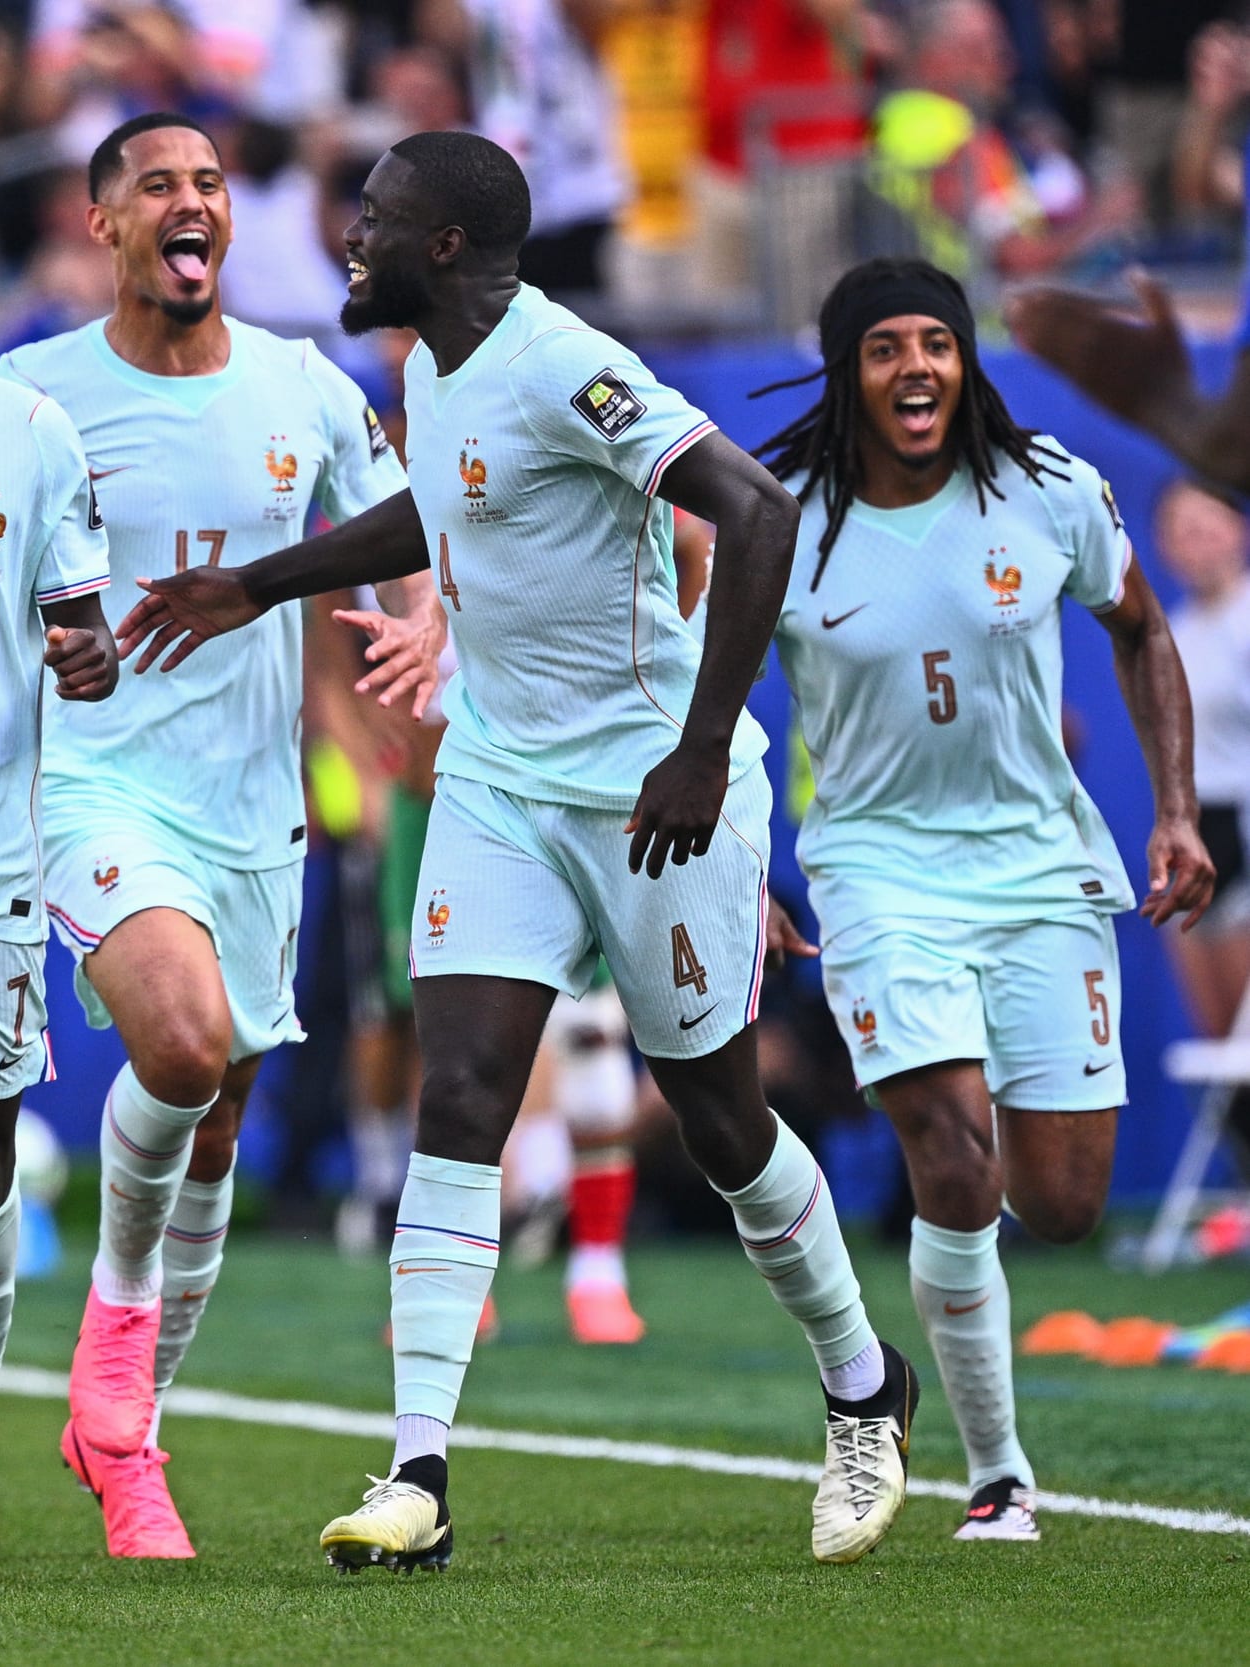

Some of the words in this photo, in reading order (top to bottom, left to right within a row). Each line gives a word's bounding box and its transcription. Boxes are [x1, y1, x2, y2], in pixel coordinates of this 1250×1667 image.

[176, 530, 228, 575] 17
[439, 532, 461, 612] 4
[922, 650, 957, 725] 5
[671, 922, 708, 996] 4
[6, 972, 30, 1048] 7
[1084, 970, 1112, 1047] 5
